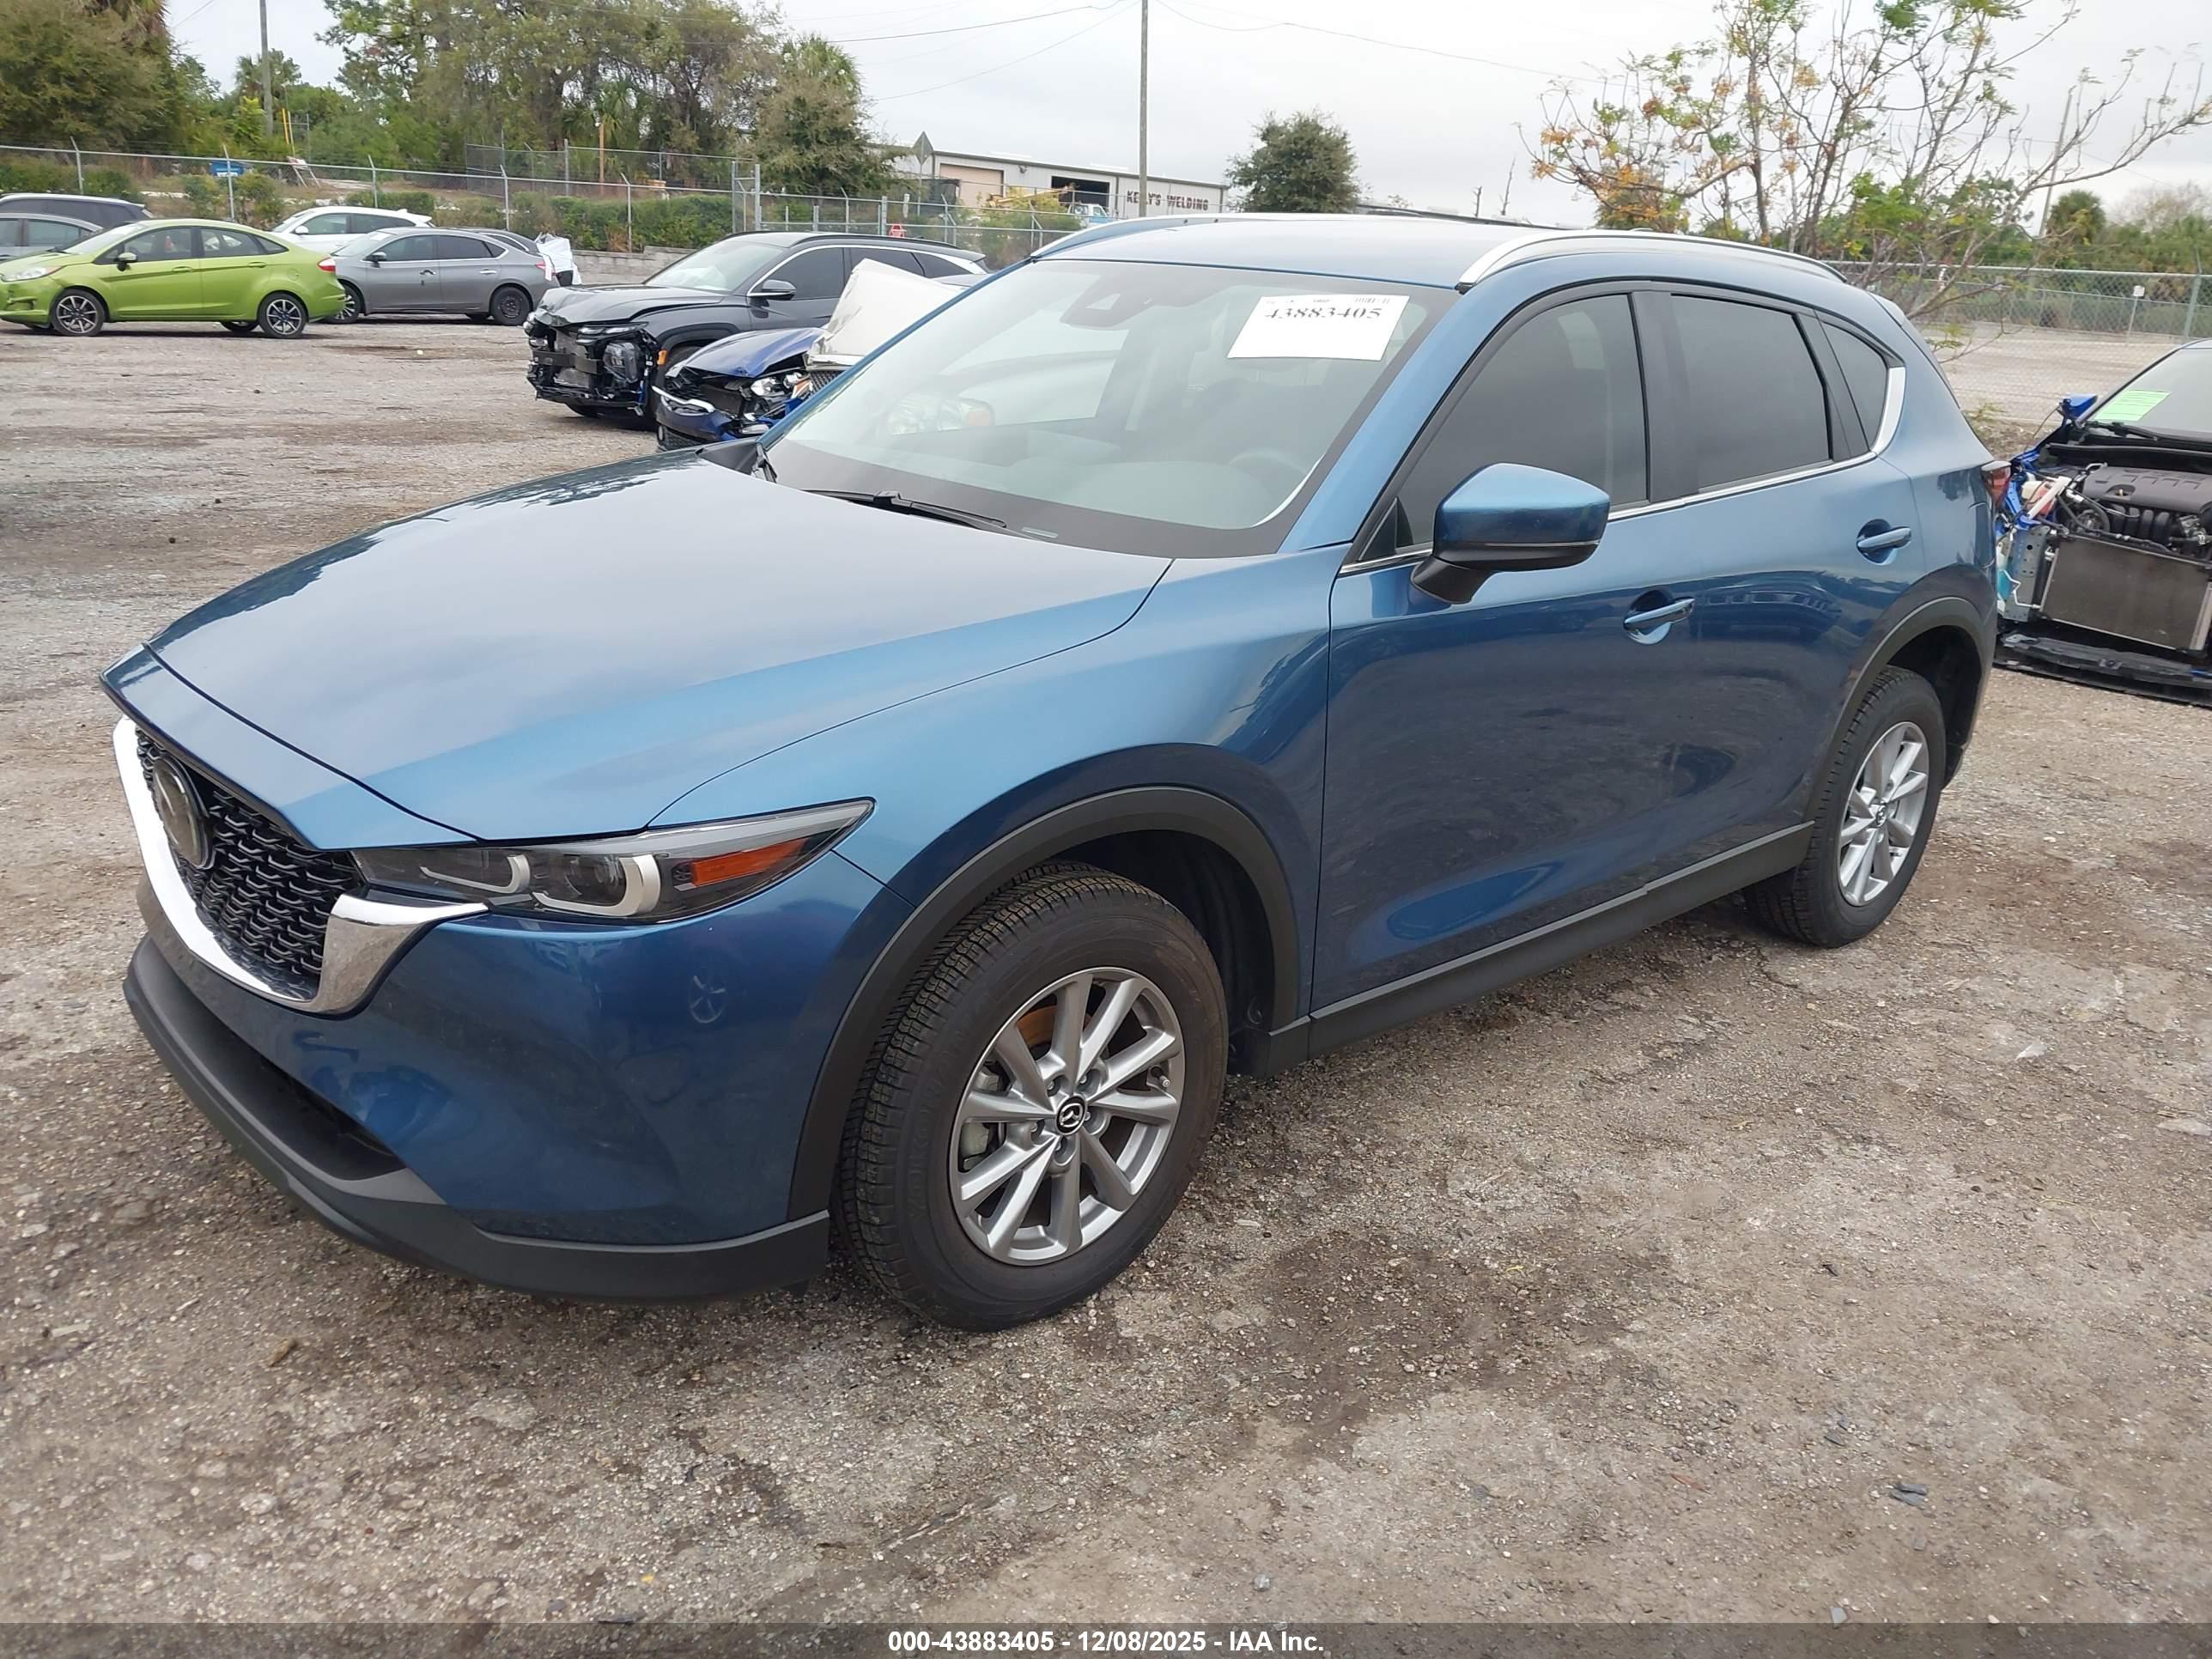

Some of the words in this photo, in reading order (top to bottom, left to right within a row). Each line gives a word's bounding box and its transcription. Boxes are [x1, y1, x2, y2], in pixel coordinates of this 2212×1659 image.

[1127, 191, 1162, 206] KEY'S
[1166, 195, 1209, 211] WELDING
[1266, 307, 1382, 319] 43883405
